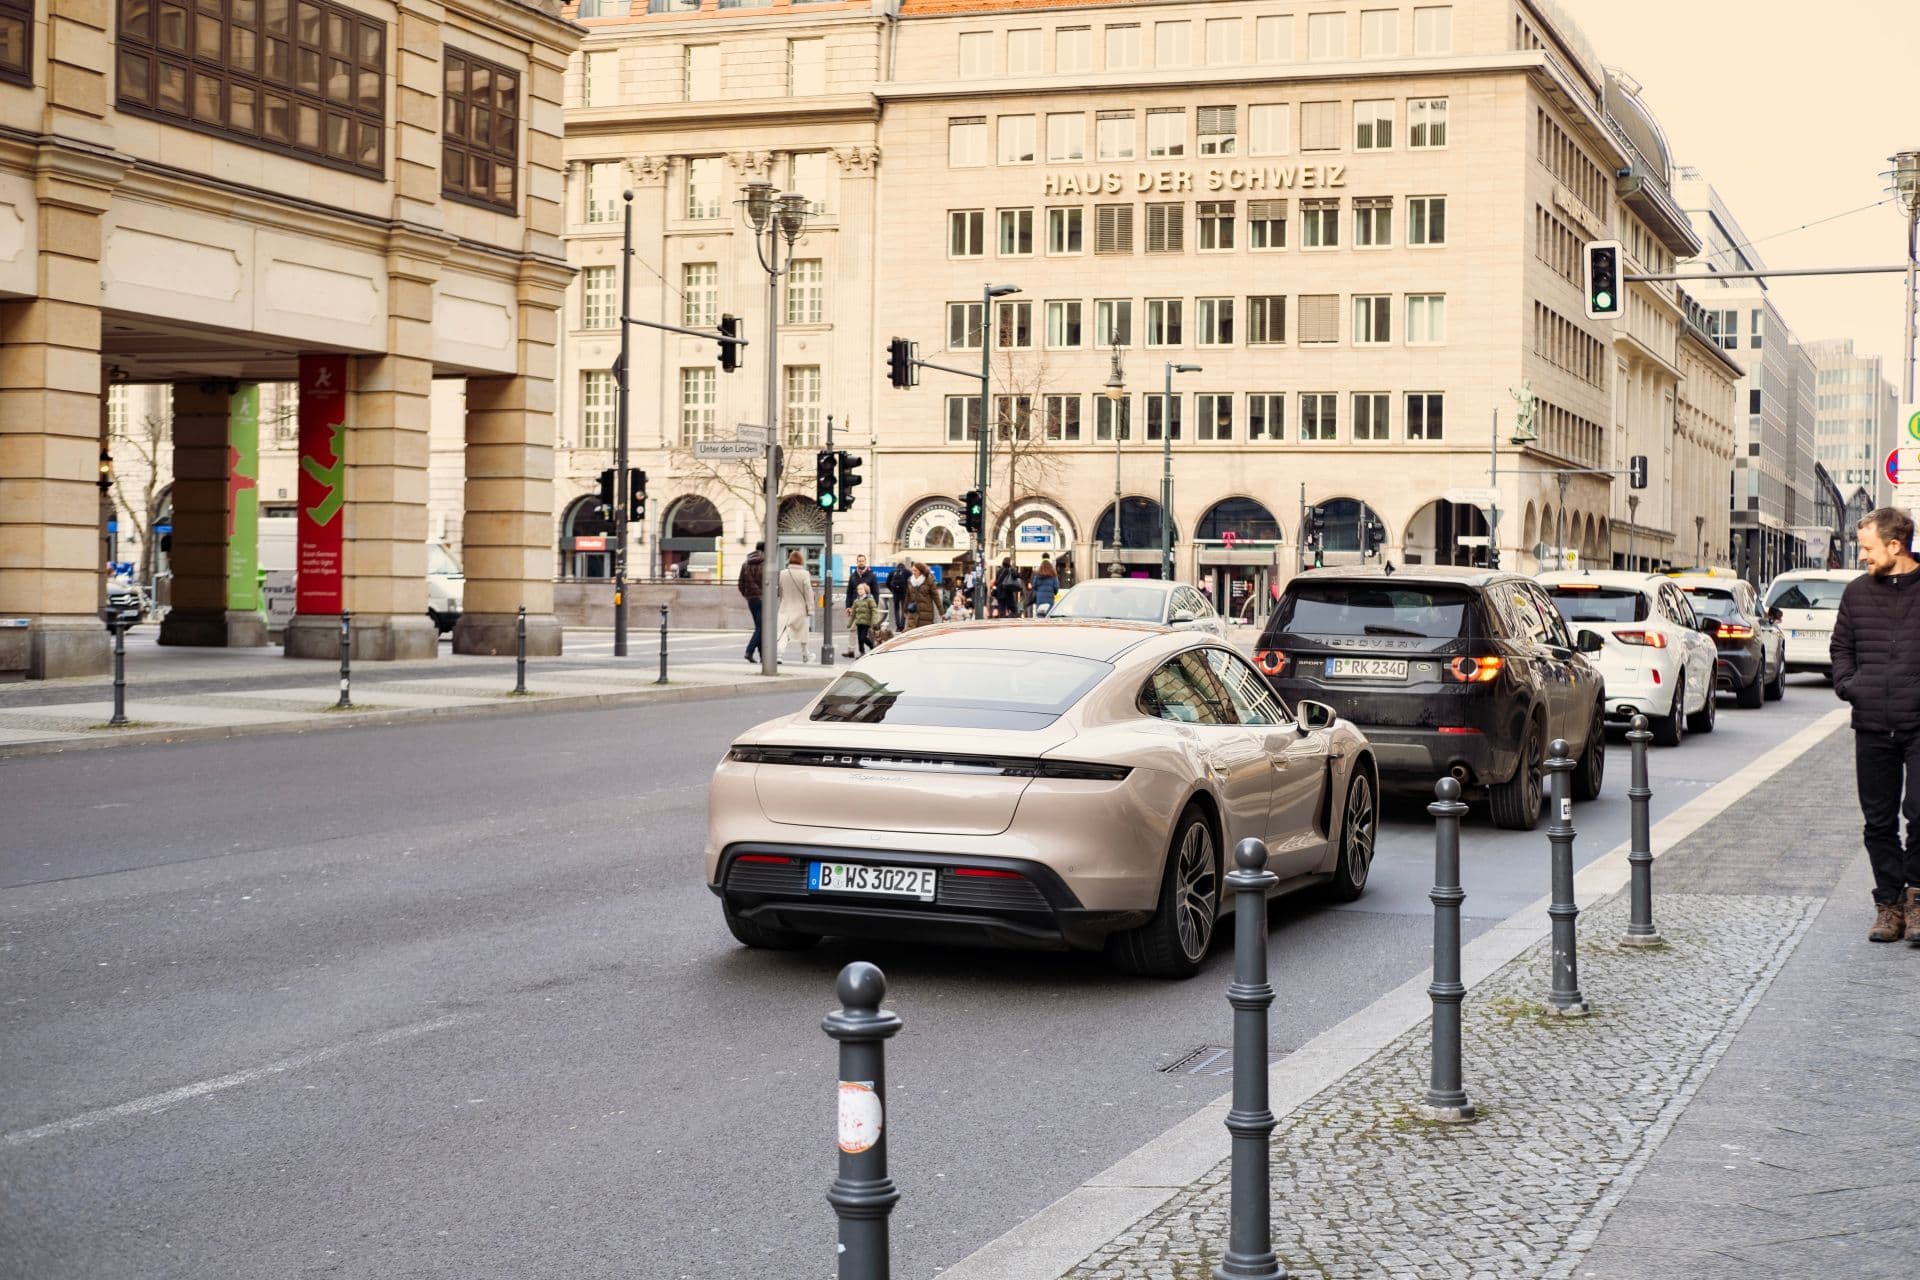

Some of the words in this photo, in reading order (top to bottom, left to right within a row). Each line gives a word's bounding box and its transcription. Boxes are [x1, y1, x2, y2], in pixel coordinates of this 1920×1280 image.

[1041, 169, 1122, 195] HAUS
[1135, 167, 1194, 193] DER
[1206, 163, 1346, 191] SCHWEIZ
[700, 444, 719, 453] Unter
[720, 444, 734, 453] den
[735, 444, 758, 453] Linden
[1334, 660, 1343, 673] B
[1352, 662, 1369, 674] RK
[821, 865, 832, 887] B
